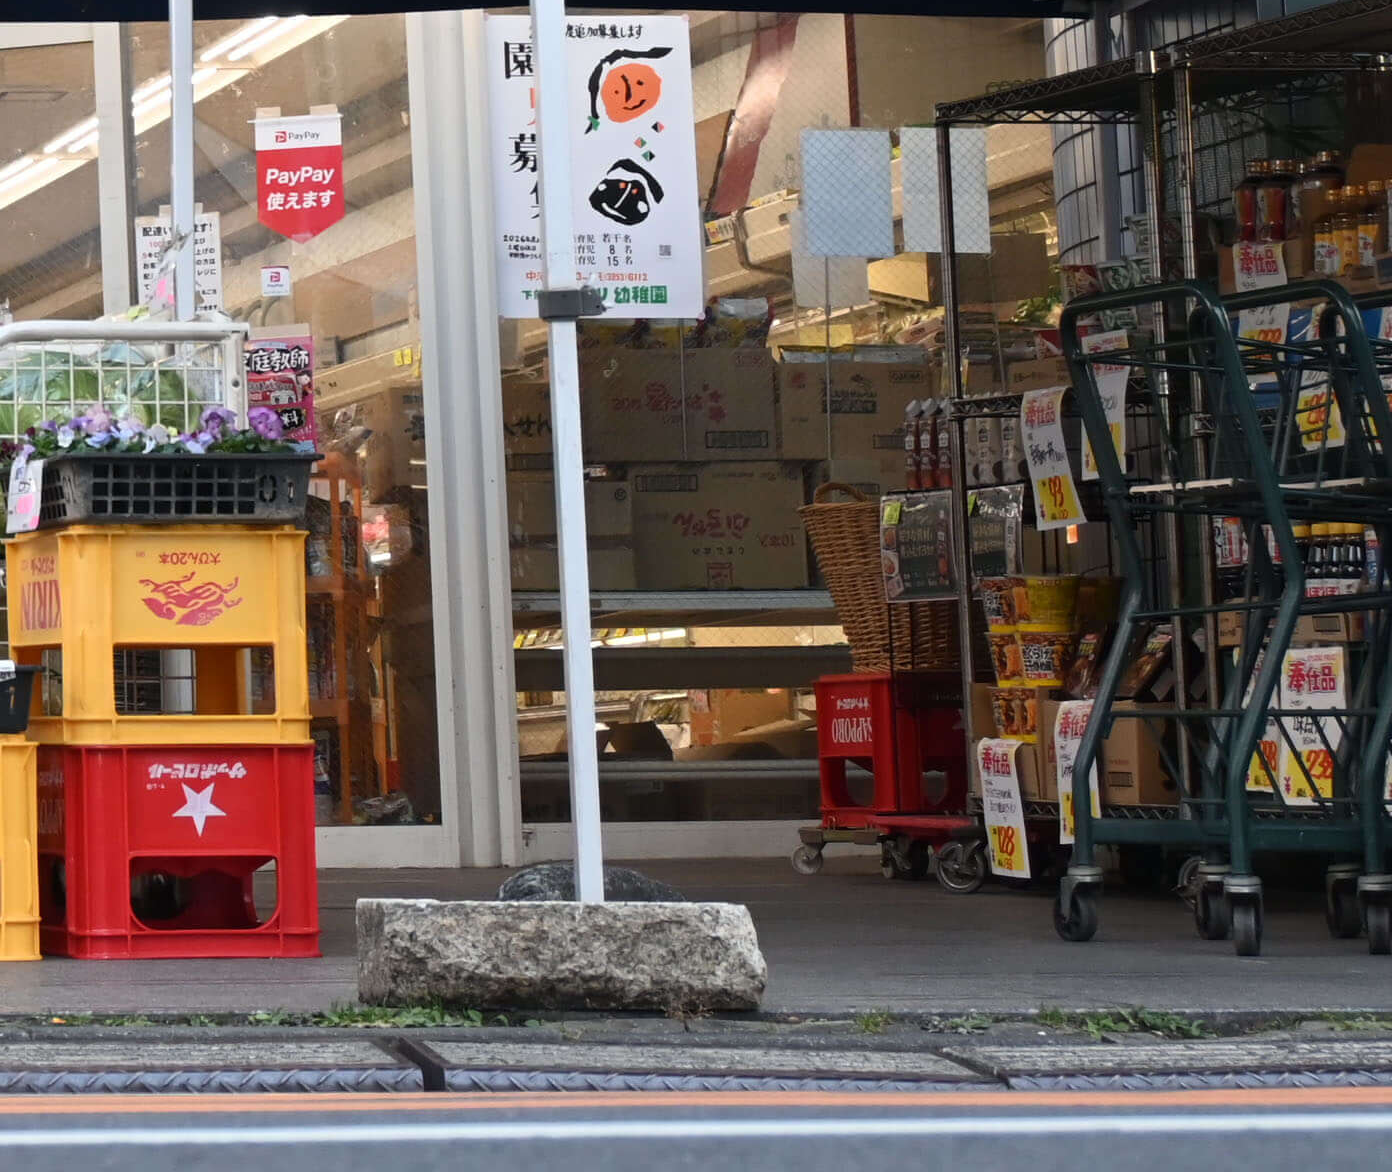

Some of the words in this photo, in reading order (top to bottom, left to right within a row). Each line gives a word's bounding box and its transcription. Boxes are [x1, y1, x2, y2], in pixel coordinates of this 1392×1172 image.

[288, 131, 320, 141] PayPay
[266, 167, 335, 187] PayPay
[267, 190, 336, 211] 使えます
[614, 285, 668, 305] 幼稚園
[158, 551, 222, 566] 大びん20本
[21, 579, 63, 630] KIRIN
[1287, 661, 1337, 694] 奉仕品
[148, 761, 247, 779] サッポロビール
[982, 746, 1012, 777] 奉仕品
